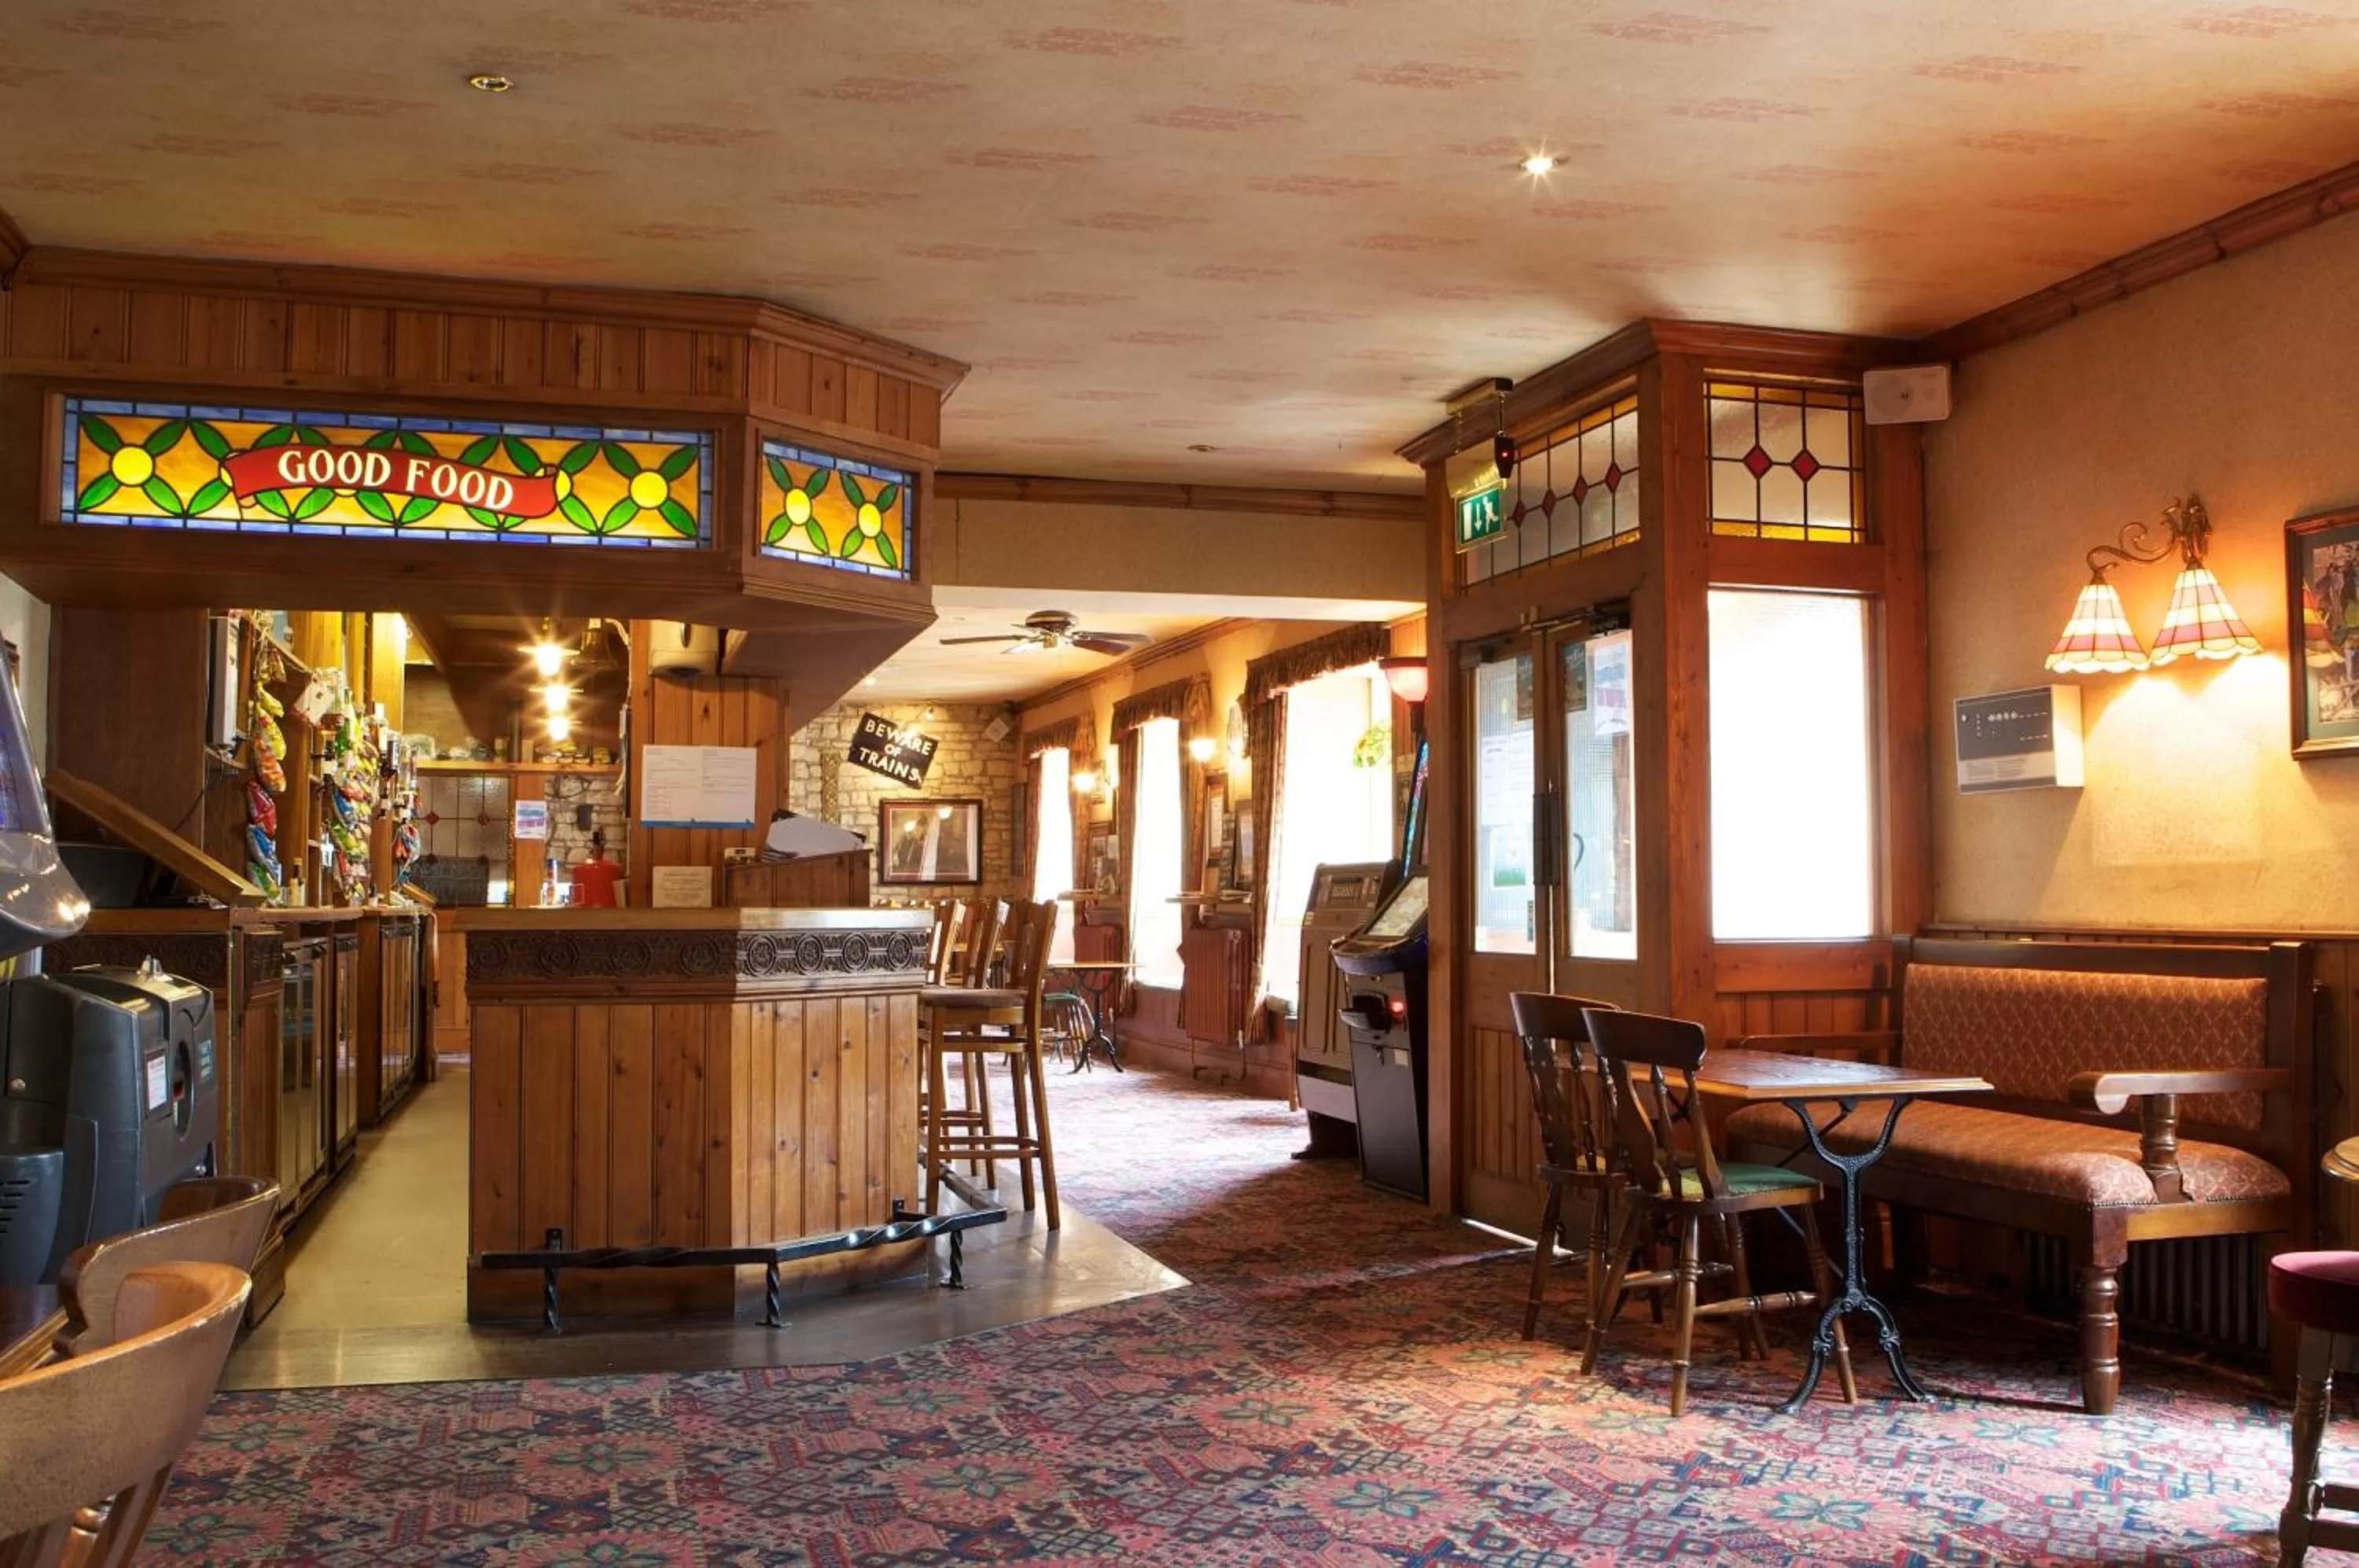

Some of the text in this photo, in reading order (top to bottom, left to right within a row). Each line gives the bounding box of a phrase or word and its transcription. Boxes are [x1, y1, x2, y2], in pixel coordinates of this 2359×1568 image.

[278, 449, 513, 510] GOOD FOOD
[865, 719, 933, 756] BEWARE
[884, 743, 903, 757] OF
[859, 747, 920, 781] TRAINS
